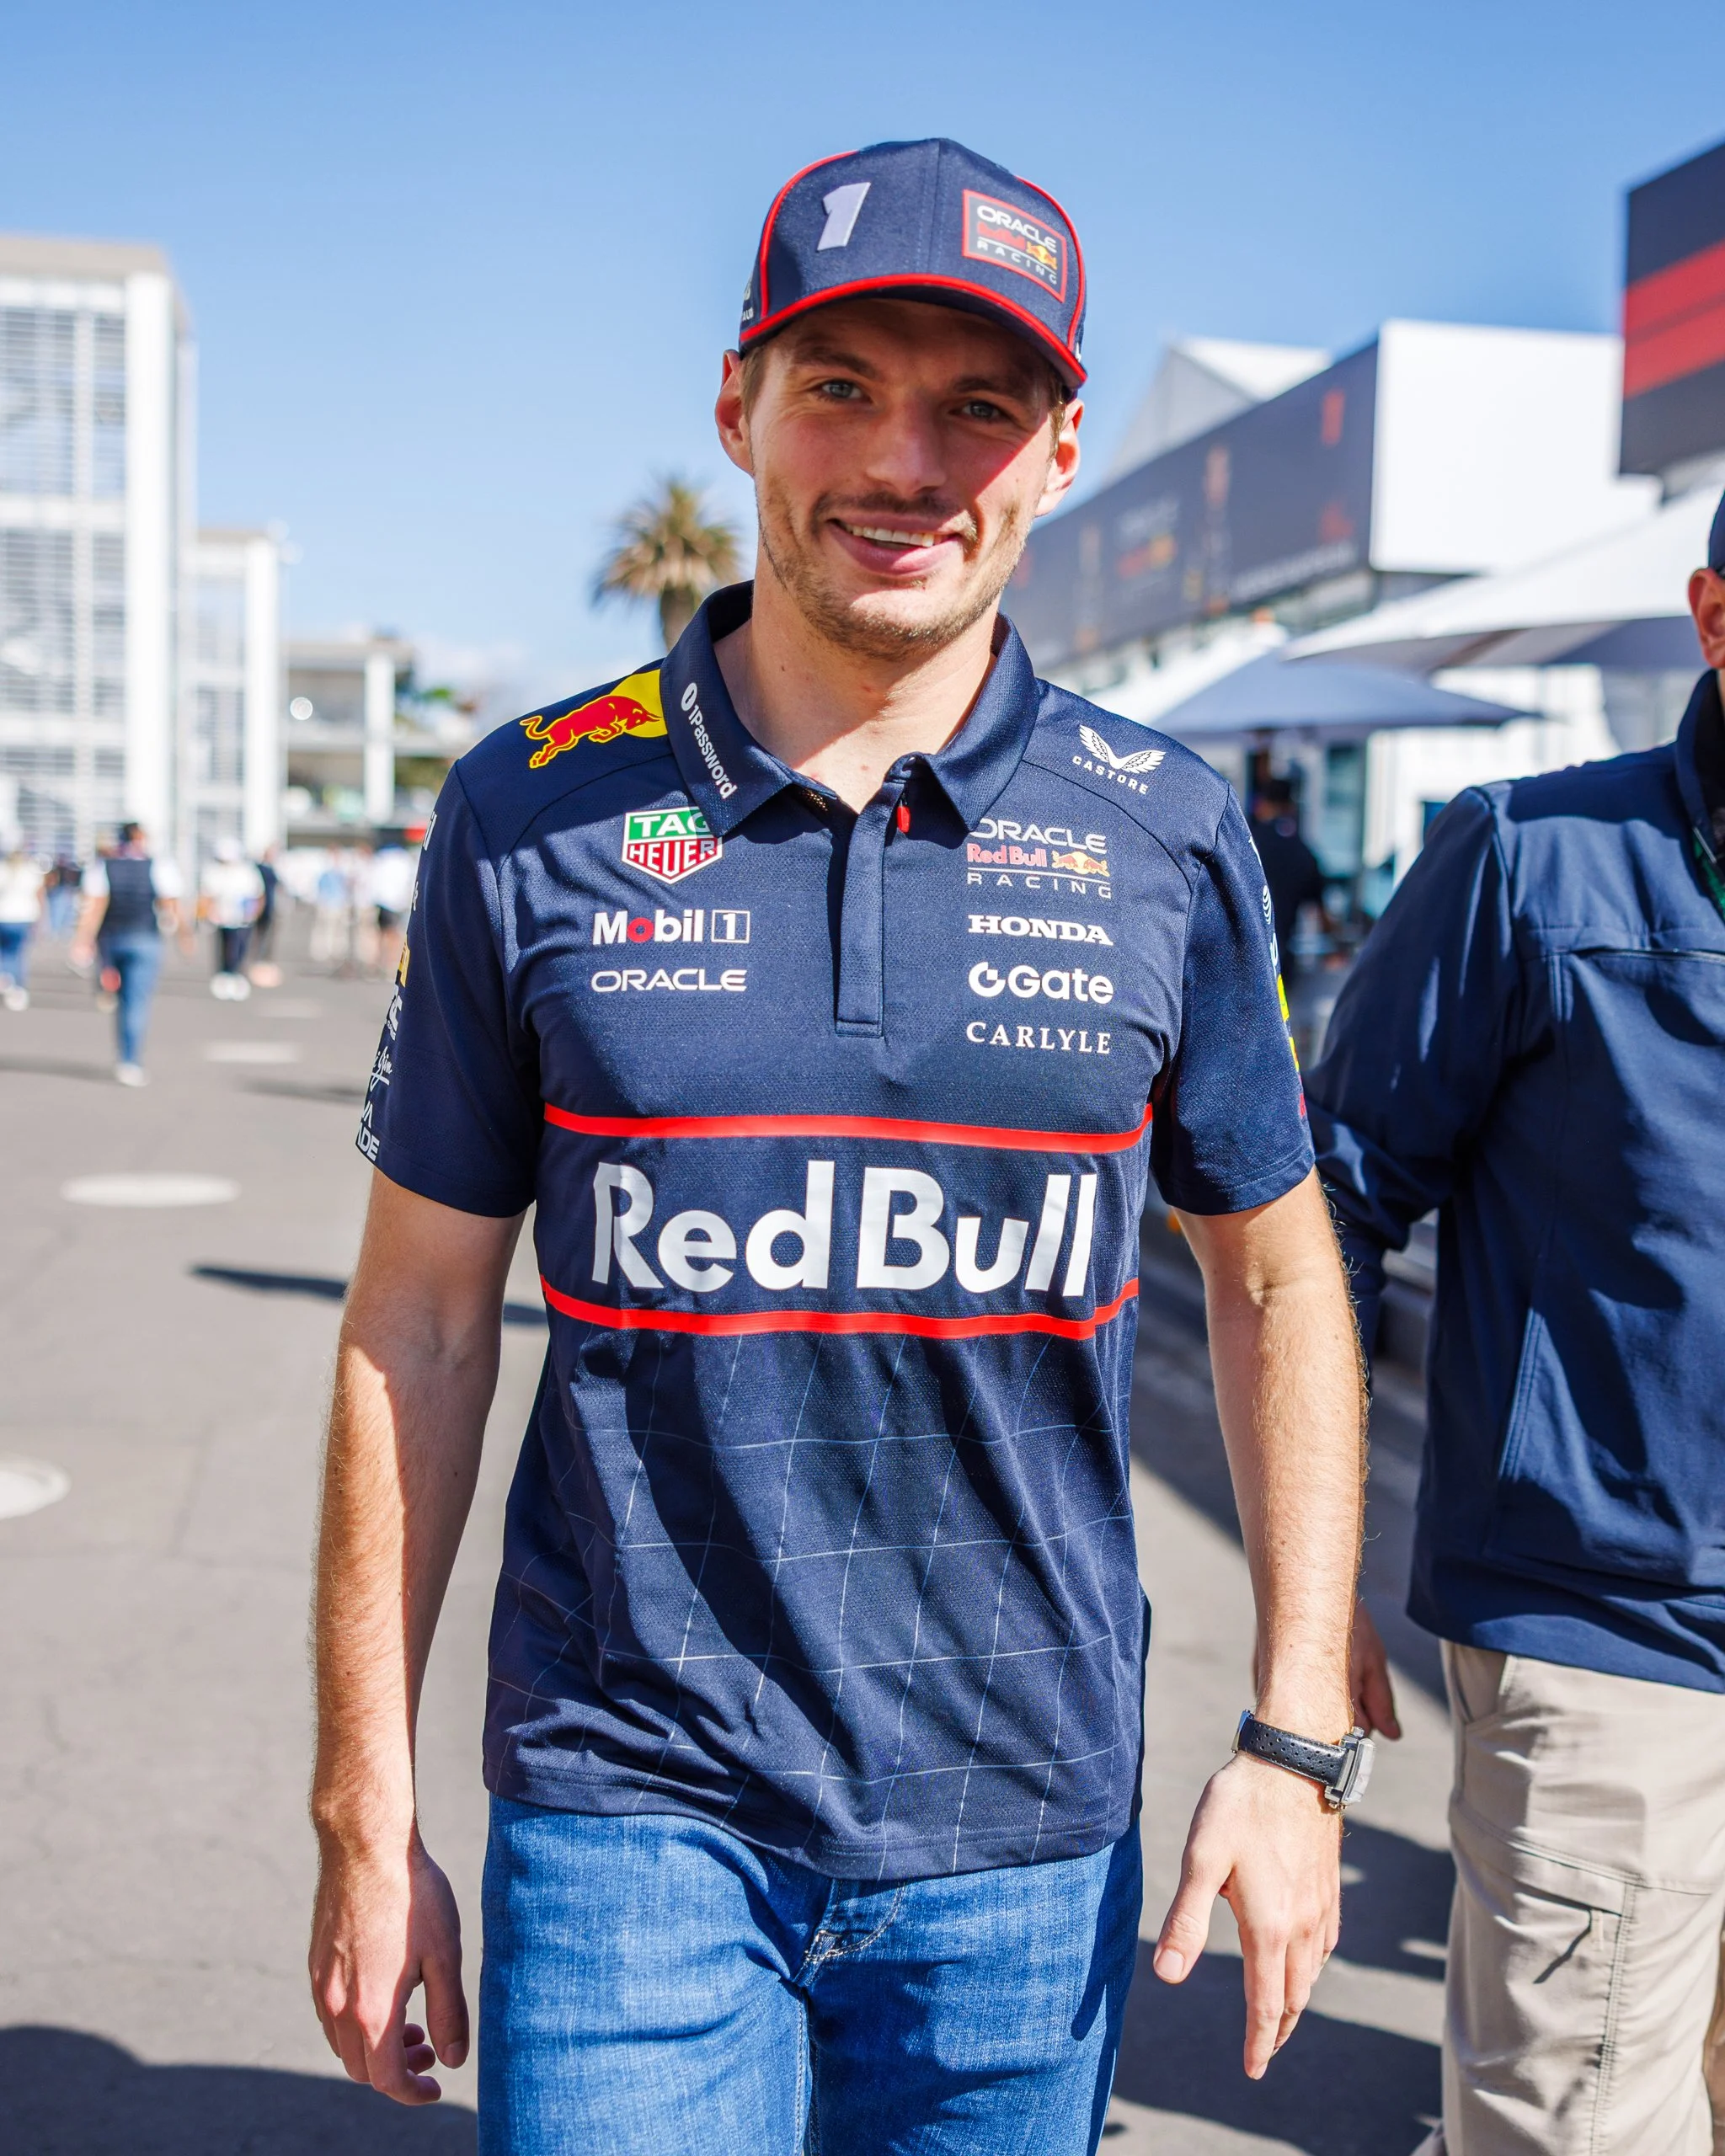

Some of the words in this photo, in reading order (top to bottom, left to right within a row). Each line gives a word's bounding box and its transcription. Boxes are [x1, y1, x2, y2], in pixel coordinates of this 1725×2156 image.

[817, 182, 871, 251] 1
[977, 205, 1057, 253] ORACLE
[977, 240, 1057, 285] RACING
[688, 704, 738, 799] 1Password
[1072, 755, 1149, 795] CASTORE
[633, 811, 711, 838] TAG
[969, 818, 1108, 854] ORACLE
[628, 841, 715, 877] HEUER
[967, 843, 1007, 864] Red
[1009, 846, 1048, 867] Bull
[967, 872, 1112, 899] RACING
[592, 909, 704, 946] Mobil
[968, 914, 1114, 947] HONDA
[591, 968, 748, 993] ORACLE
[966, 1021, 1111, 1055] CARLYLE
[592, 1160, 836, 1293] Red
[856, 1166, 1097, 1297] Bull
